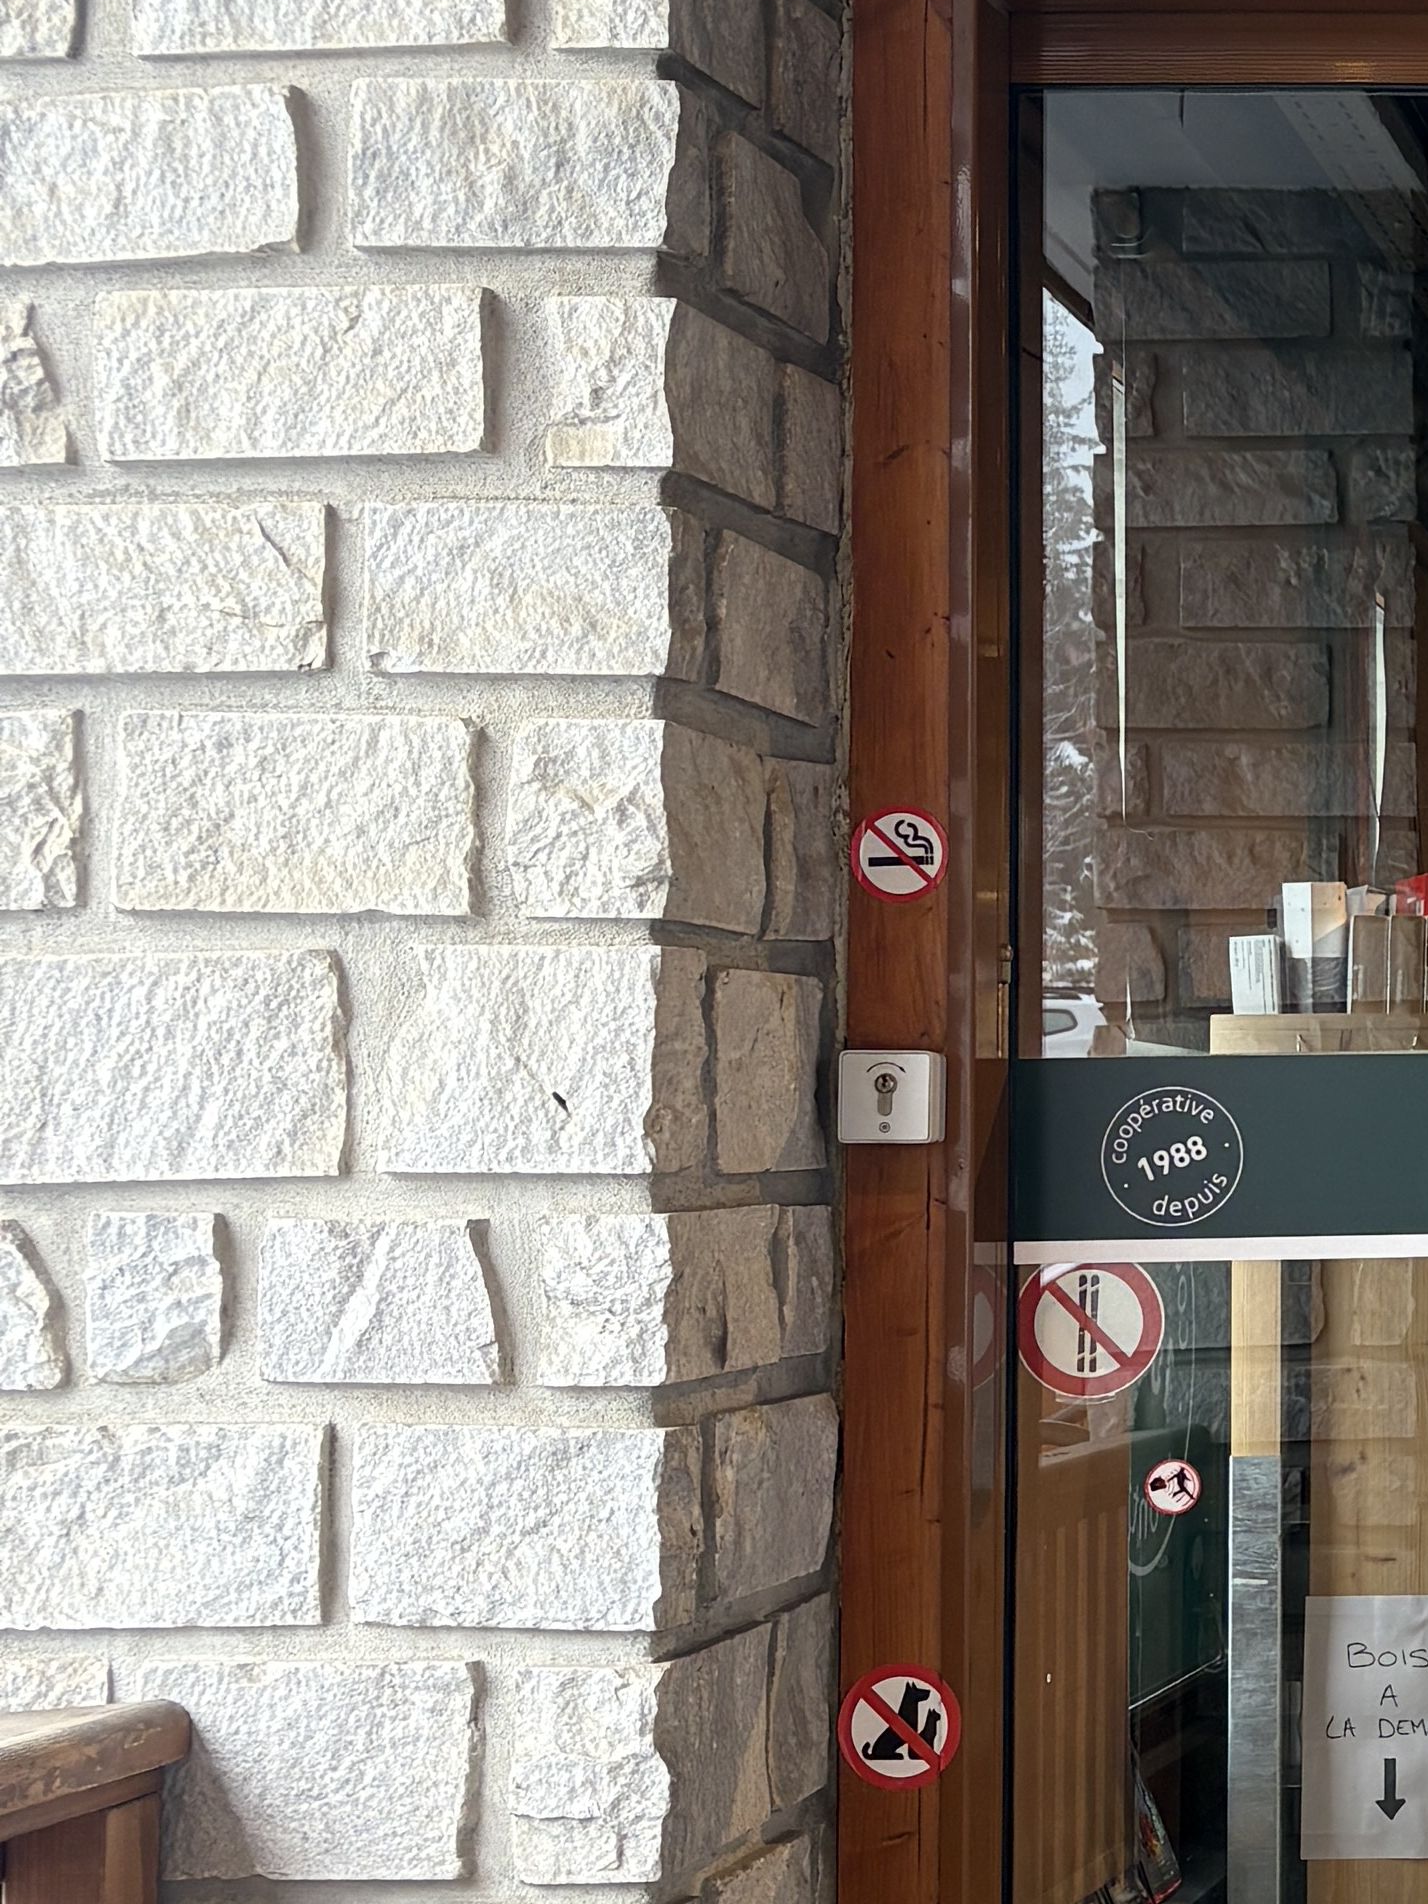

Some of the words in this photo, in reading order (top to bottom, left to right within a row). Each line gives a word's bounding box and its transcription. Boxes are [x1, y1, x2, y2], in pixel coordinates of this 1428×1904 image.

[1111, 1094, 1215, 1164] coopérative
[1137, 1135, 1208, 1181] 1988
[1152, 1173, 1228, 1219] depuis
[1379, 1683, 1398, 1707] A
[1325, 1714, 1357, 1740] LA
